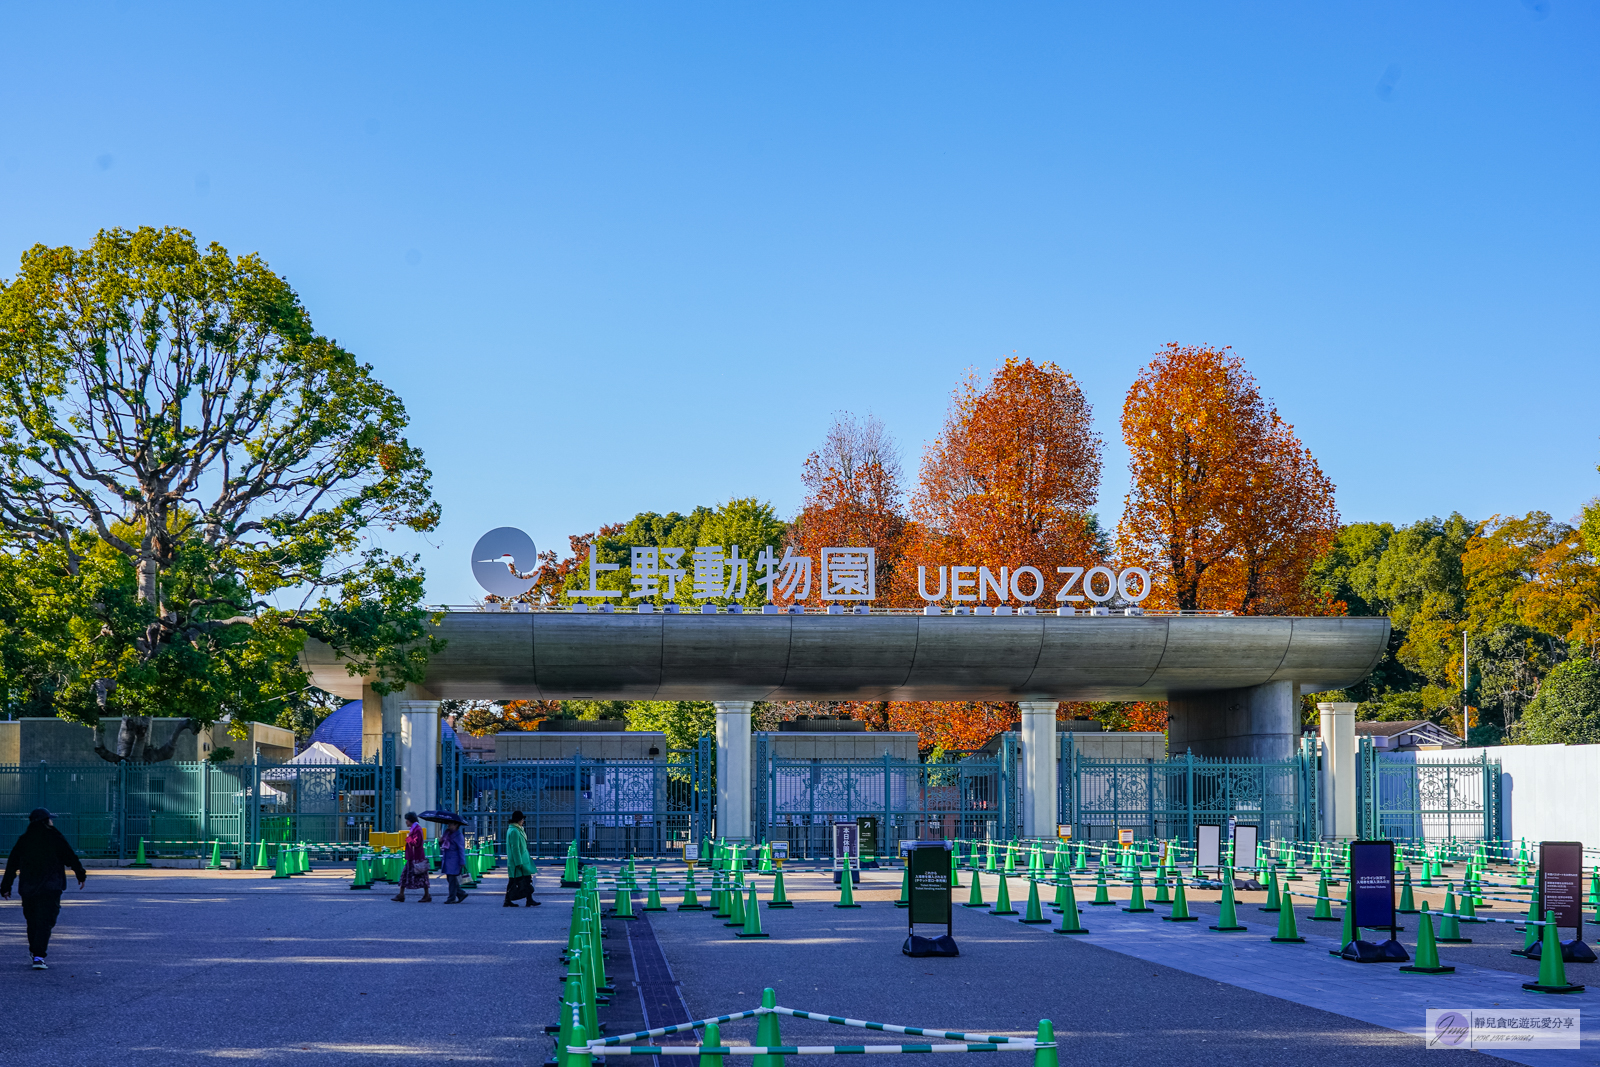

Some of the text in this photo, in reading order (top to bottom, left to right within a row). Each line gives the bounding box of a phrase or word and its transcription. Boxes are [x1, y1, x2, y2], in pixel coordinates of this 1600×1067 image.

[567, 544, 875, 600] 上野動物園
[918, 565, 1151, 602] UENO ZOO
